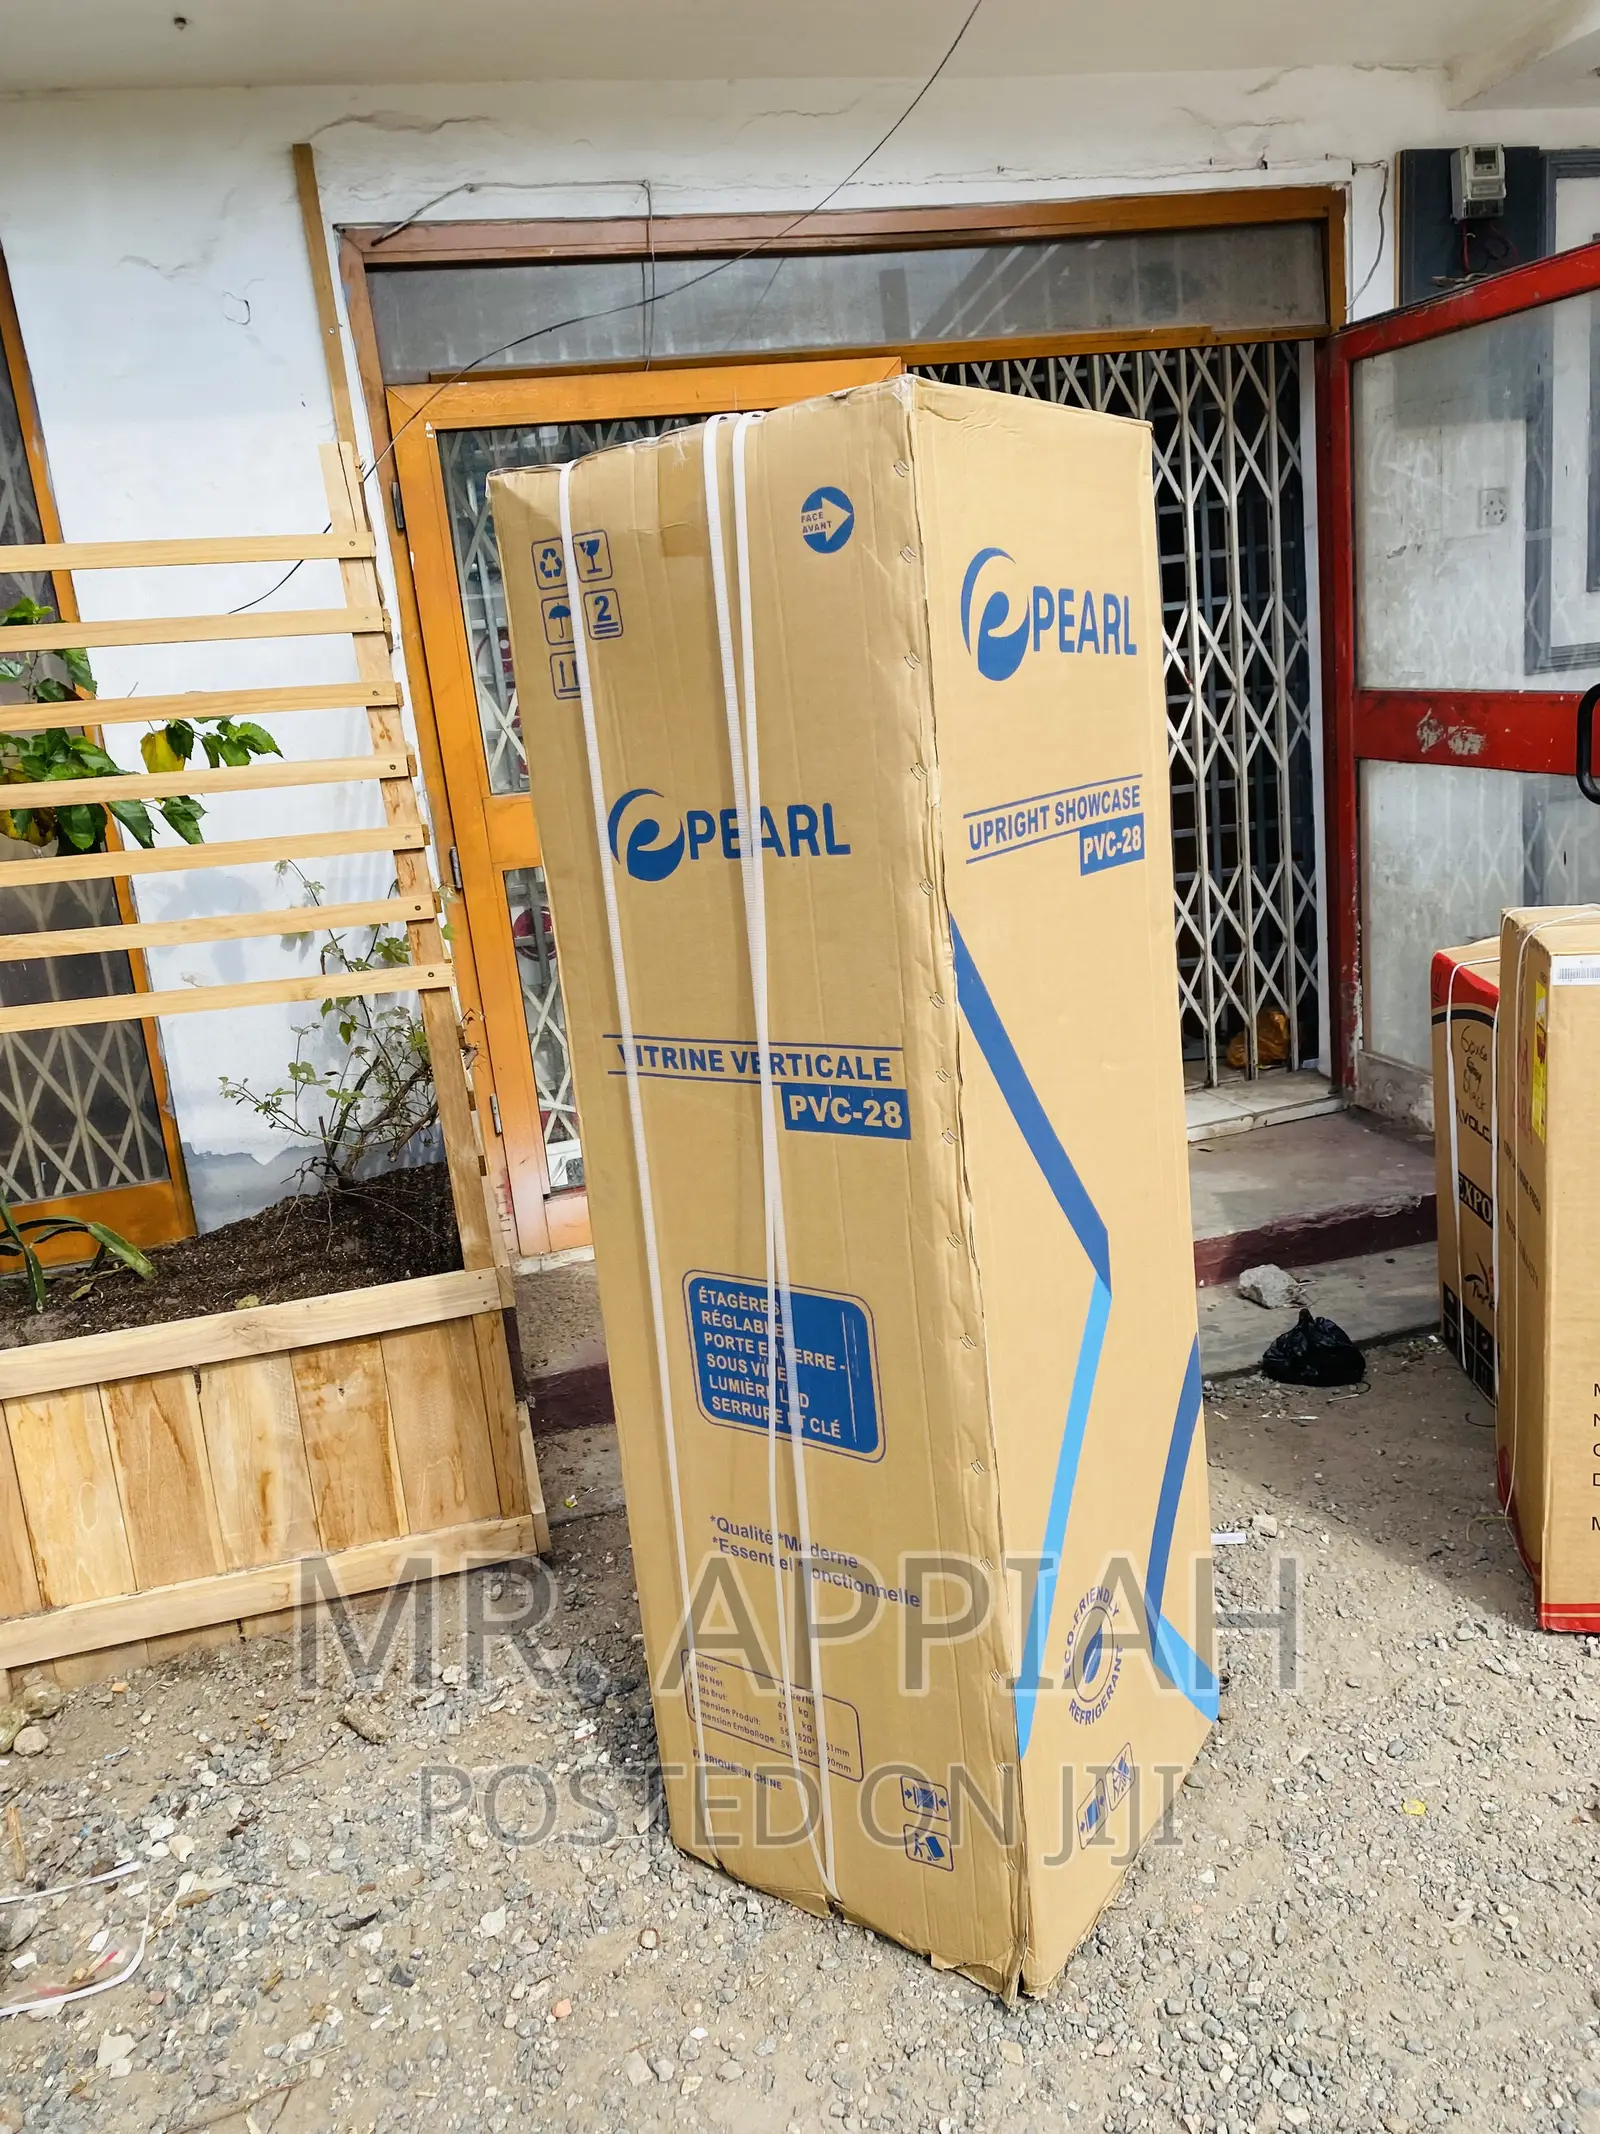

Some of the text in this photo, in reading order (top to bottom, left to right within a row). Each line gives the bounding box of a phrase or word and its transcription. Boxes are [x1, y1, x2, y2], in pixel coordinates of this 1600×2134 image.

[801, 512, 823, 523] FACE
[803, 520, 832, 534] AVANT
[594, 595, 611, 622] 2
[1033, 585, 1137, 656] PEARL
[686, 802, 852, 860] PEARL
[968, 784, 1141, 850] UPRIGHT SHOWCASE
[1083, 824, 1142, 865] PVC-28
[730, 1050, 892, 1082] VERTICALE
[788, 1094, 903, 1129] PVC-28
[699, 1285, 780, 1316] ÉTAGÈRES
[701, 1309, 785, 1339] RÉGLABE
[703, 1331, 756, 1355] PORTE
[782, 1346, 836, 1371] ERRE
[706, 1353, 788, 1383] SOUS VIE
[779, 1387, 810, 1409] LD
[711, 1395, 784, 1425] SERRURE
[809, 1417, 842, 1440] CLÉ
[778, 1532, 859, 1569] Mderne
[712, 1535, 921, 1608] Essentel onctionnelle
[1064, 1585, 1120, 1681] ECO-FRIENDLY
[1068, 1643, 1124, 1726] REFRIGERANT
[754, 1772, 783, 1791] CHINE
